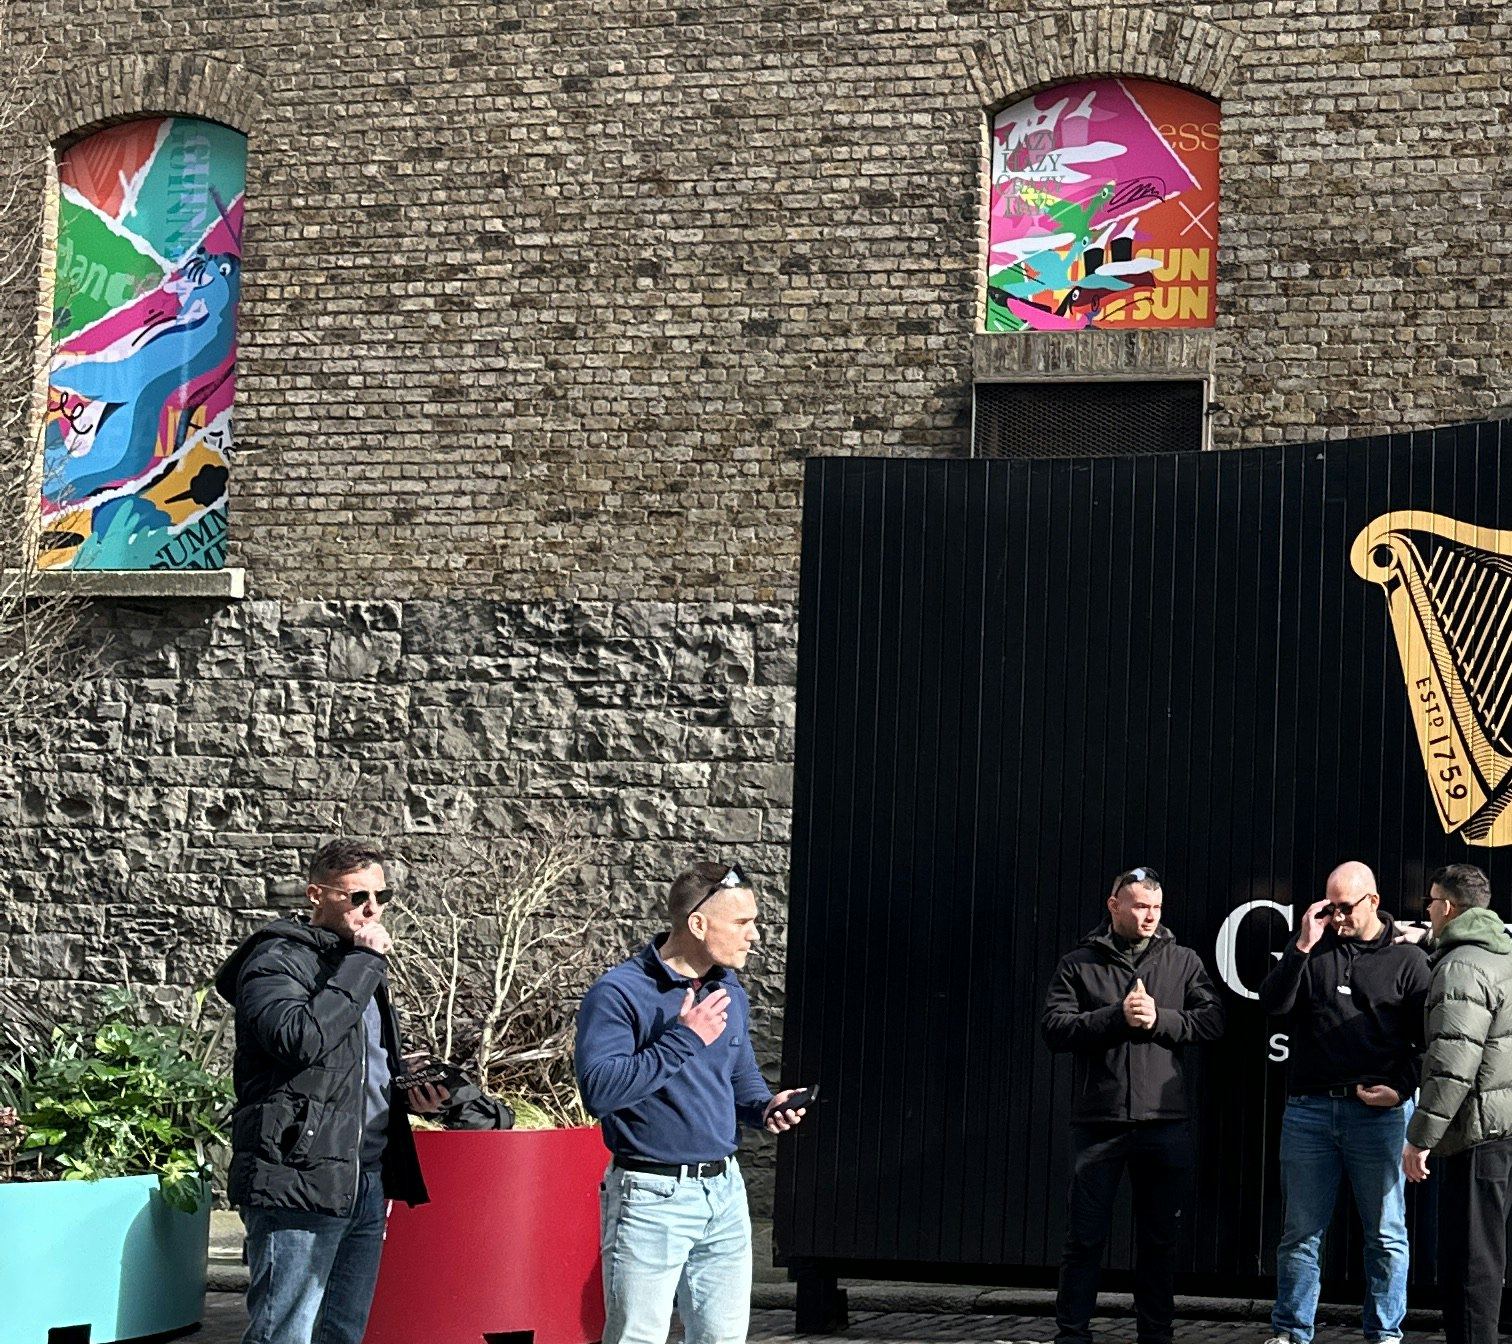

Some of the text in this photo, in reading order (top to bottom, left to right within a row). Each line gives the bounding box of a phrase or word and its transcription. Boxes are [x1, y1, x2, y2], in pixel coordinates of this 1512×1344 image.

[1001, 153, 1061, 173] HAZY
[996, 174, 1066, 195] CRAZY
[1132, 286, 1209, 321] SUN
[1429, 734, 1469, 800] 1759
